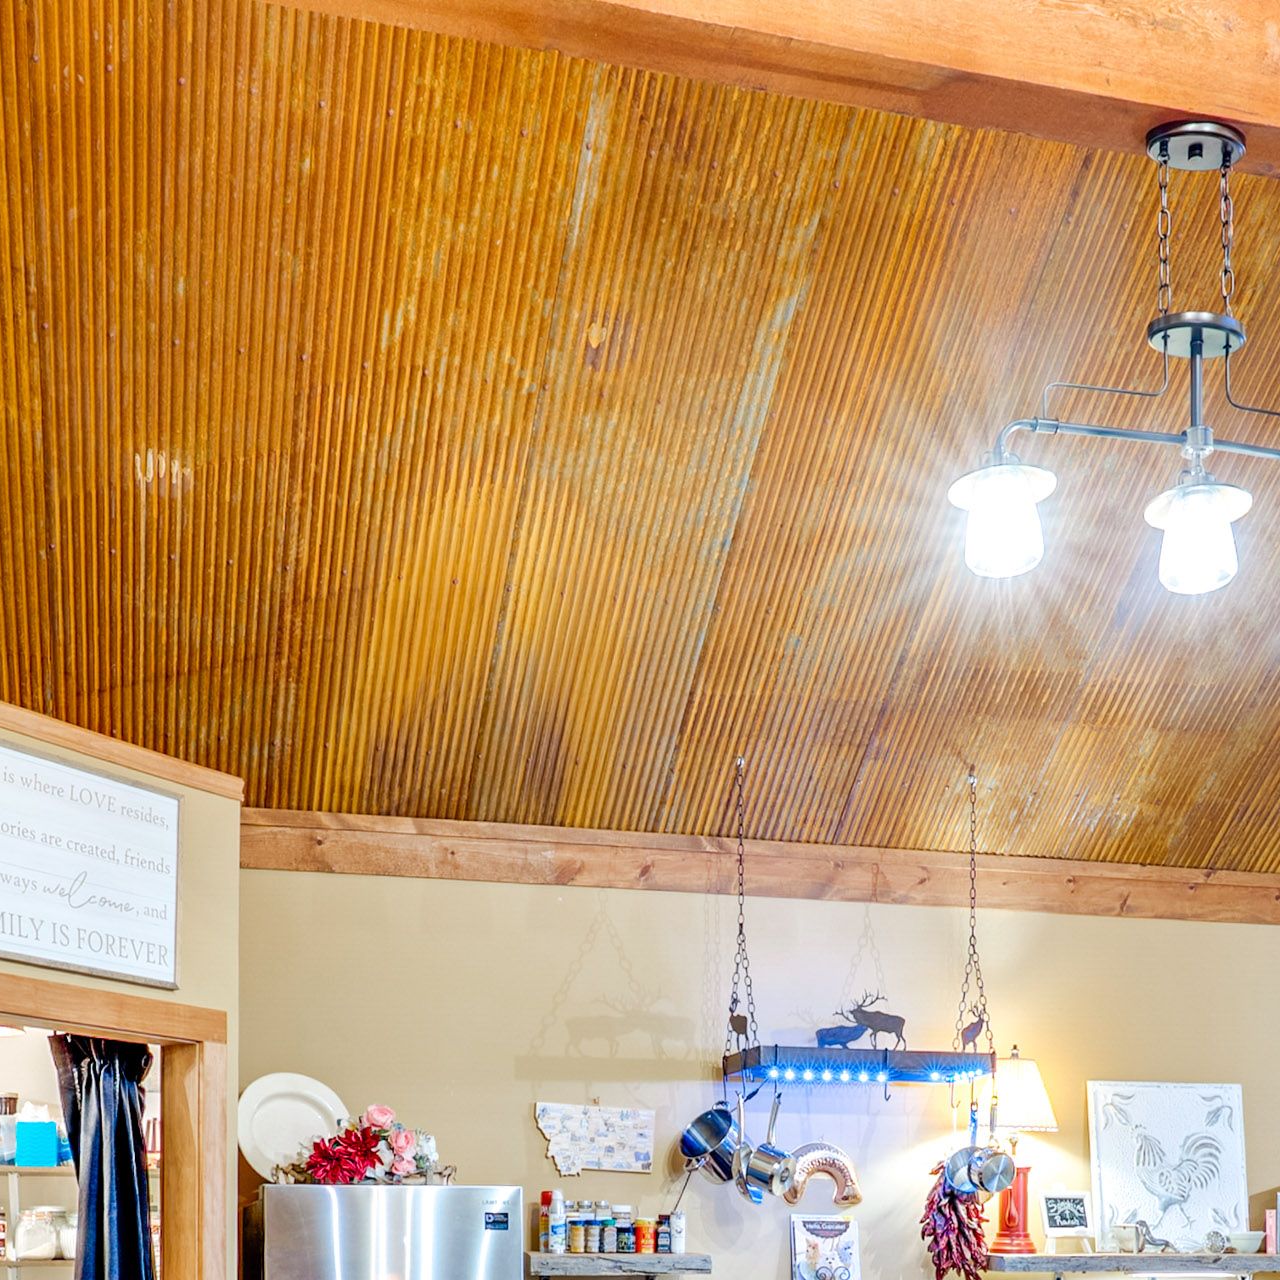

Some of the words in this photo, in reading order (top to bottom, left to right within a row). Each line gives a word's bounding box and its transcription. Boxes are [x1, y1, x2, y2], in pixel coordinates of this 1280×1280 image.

[3, 766, 15, 784] is
[20, 773, 65, 798] where
[70, 784, 117, 813] LOVE
[120, 806, 169, 831] resides,
[40, 832, 63, 848] are
[66, 839, 120, 865] created,
[124, 847, 171, 875] friends
[143, 904, 168, 920] and
[51, 921, 70, 947] IS
[76, 927, 169, 967] FOREVER
